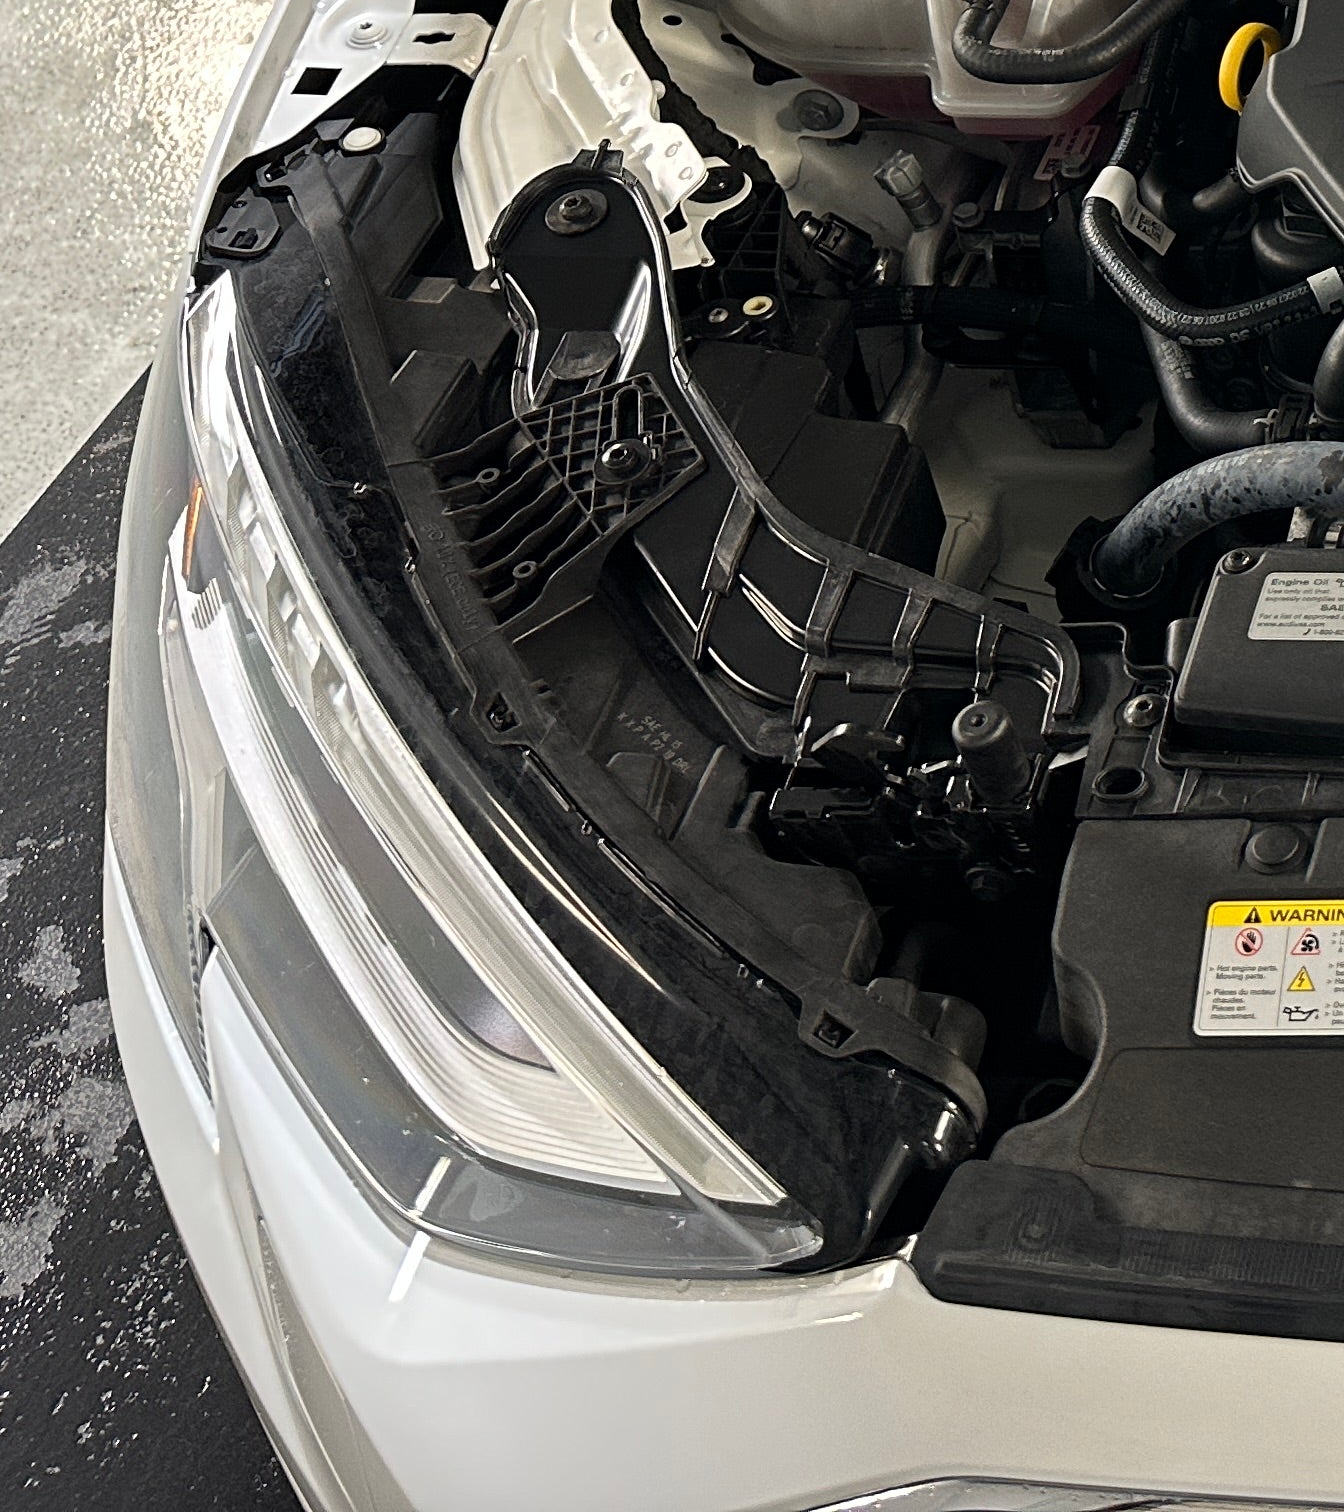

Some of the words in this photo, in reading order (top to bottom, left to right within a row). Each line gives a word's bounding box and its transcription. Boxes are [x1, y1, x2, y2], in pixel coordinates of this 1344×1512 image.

[1271, 578, 1309, 587] Engine
[1313, 578, 1329, 586] Oil
[1320, 604, 1344, 612] SAE
